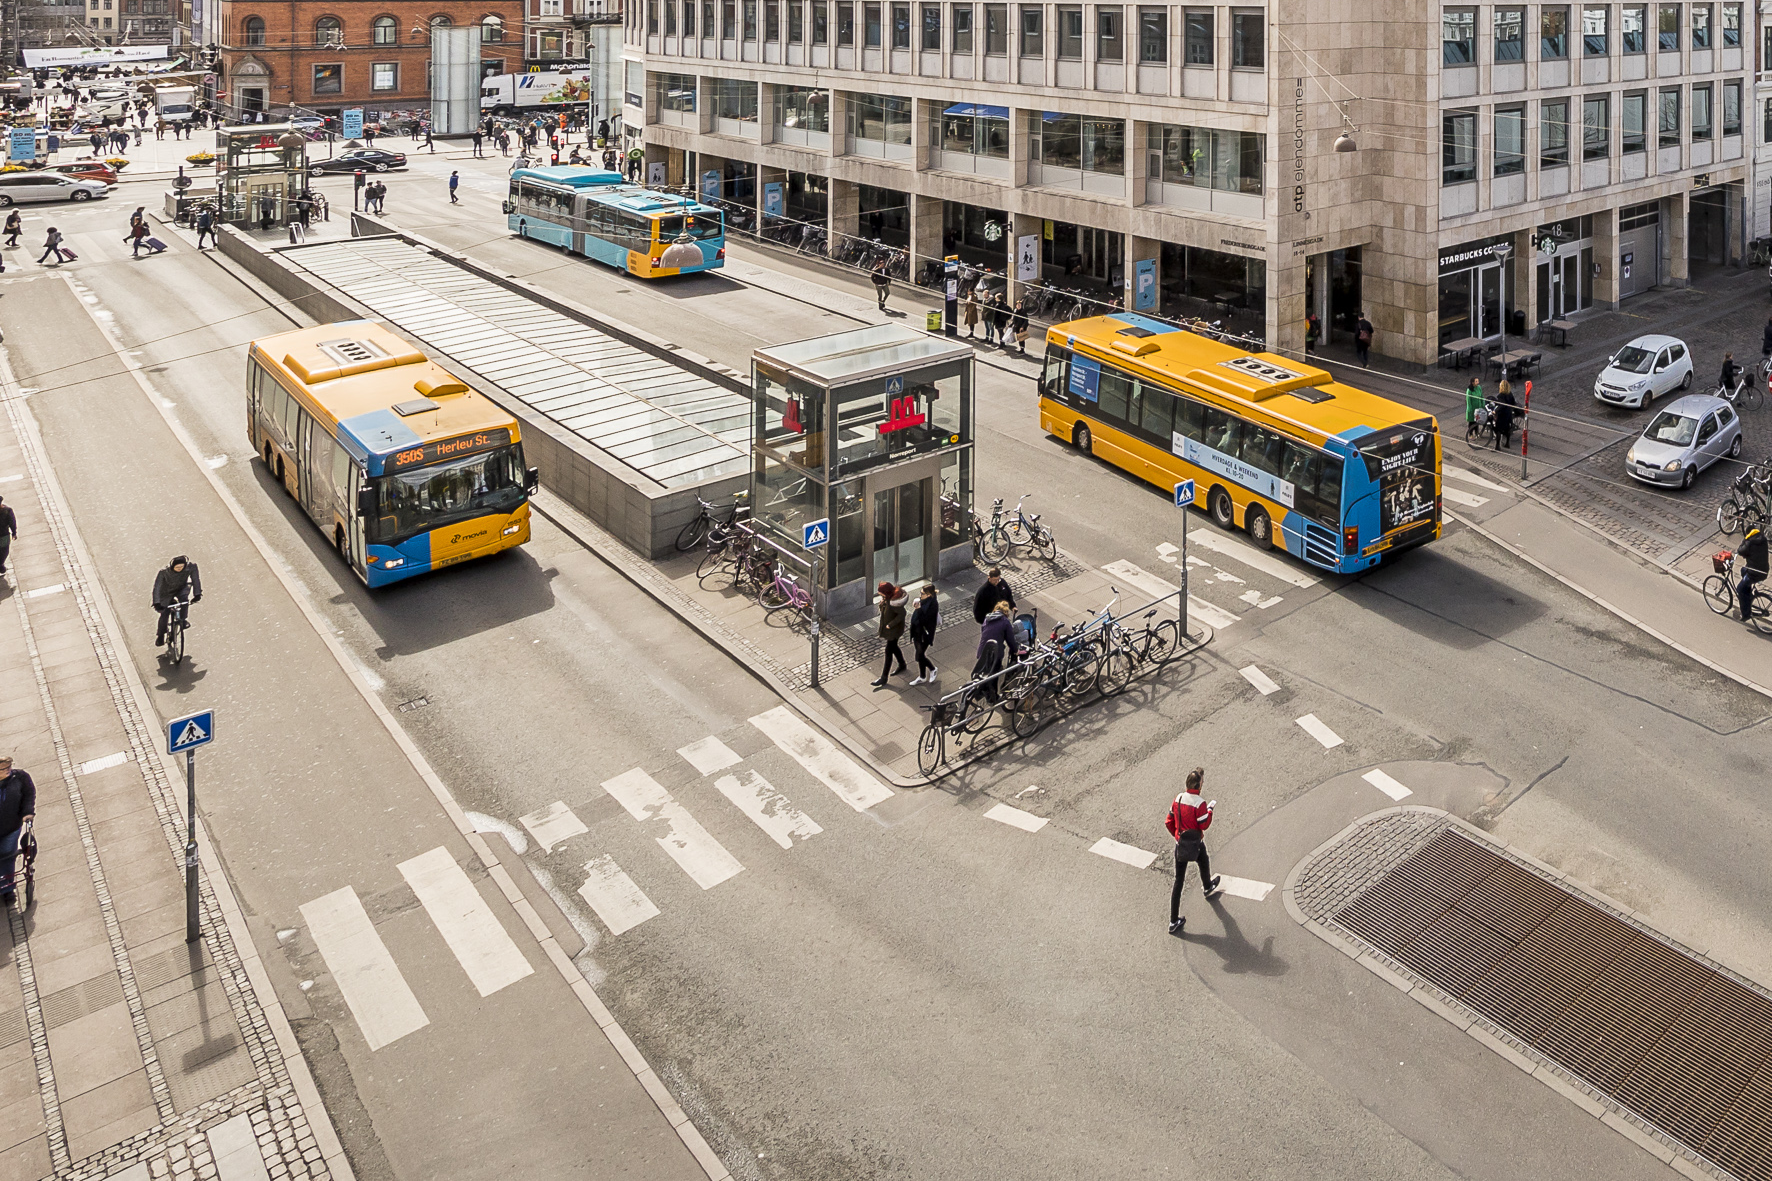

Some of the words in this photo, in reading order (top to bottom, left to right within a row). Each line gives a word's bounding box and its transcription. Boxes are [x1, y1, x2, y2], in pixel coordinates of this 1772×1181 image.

[767, 192, 780, 207] P
[1293, 185, 1305, 213] atp
[1551, 223, 1562, 236] 18
[1439, 247, 1483, 266] STARBUCKS
[1139, 273, 1153, 294] P
[396, 448, 424, 466] 350S
[437, 439, 473, 455] Herlev
[475, 435, 491, 446] St.
[1381, 453, 1402, 466] ENJOY
[1402, 448, 1419, 460] YOUR
[1211, 454, 1233, 468] HVERDAGE
[1238, 466, 1259, 480] WEEKEND
[462, 530, 488, 541] movia
